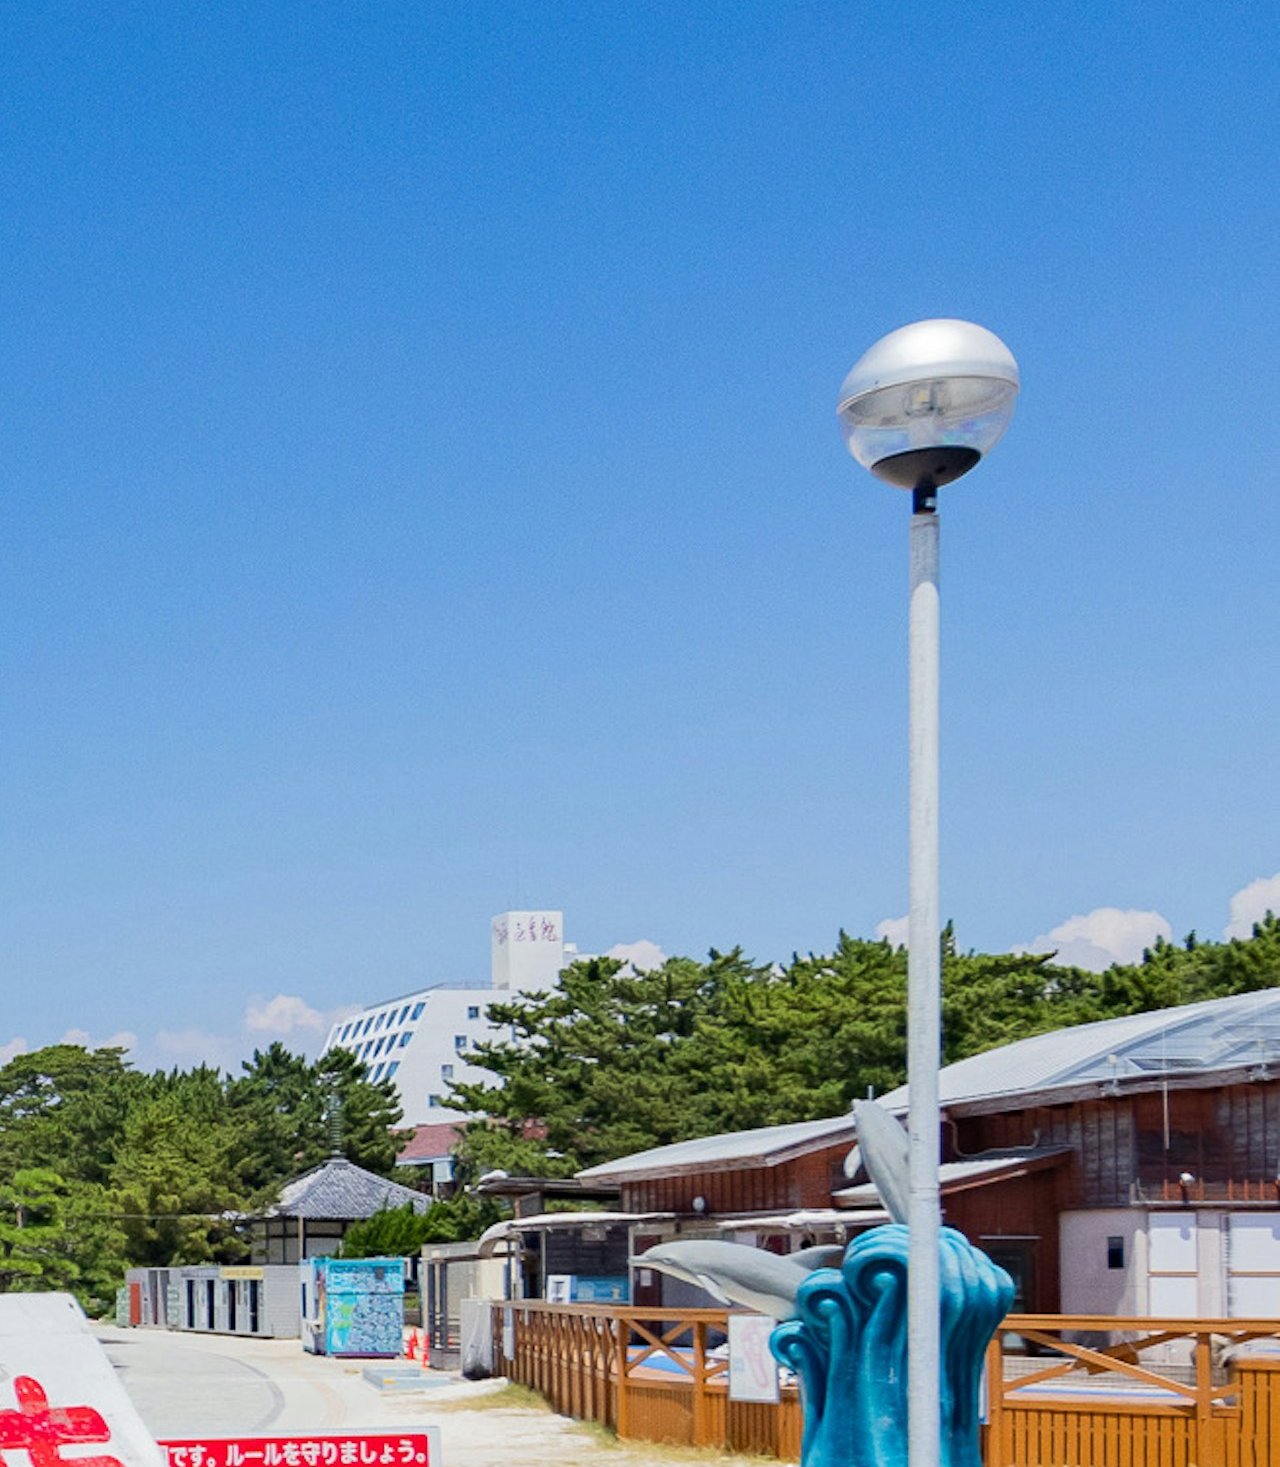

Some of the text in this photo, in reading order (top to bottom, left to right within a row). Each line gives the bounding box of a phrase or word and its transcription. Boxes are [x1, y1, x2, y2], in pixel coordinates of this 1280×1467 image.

[163, 1439, 426, 1467] です。ルールを守りましょう。
